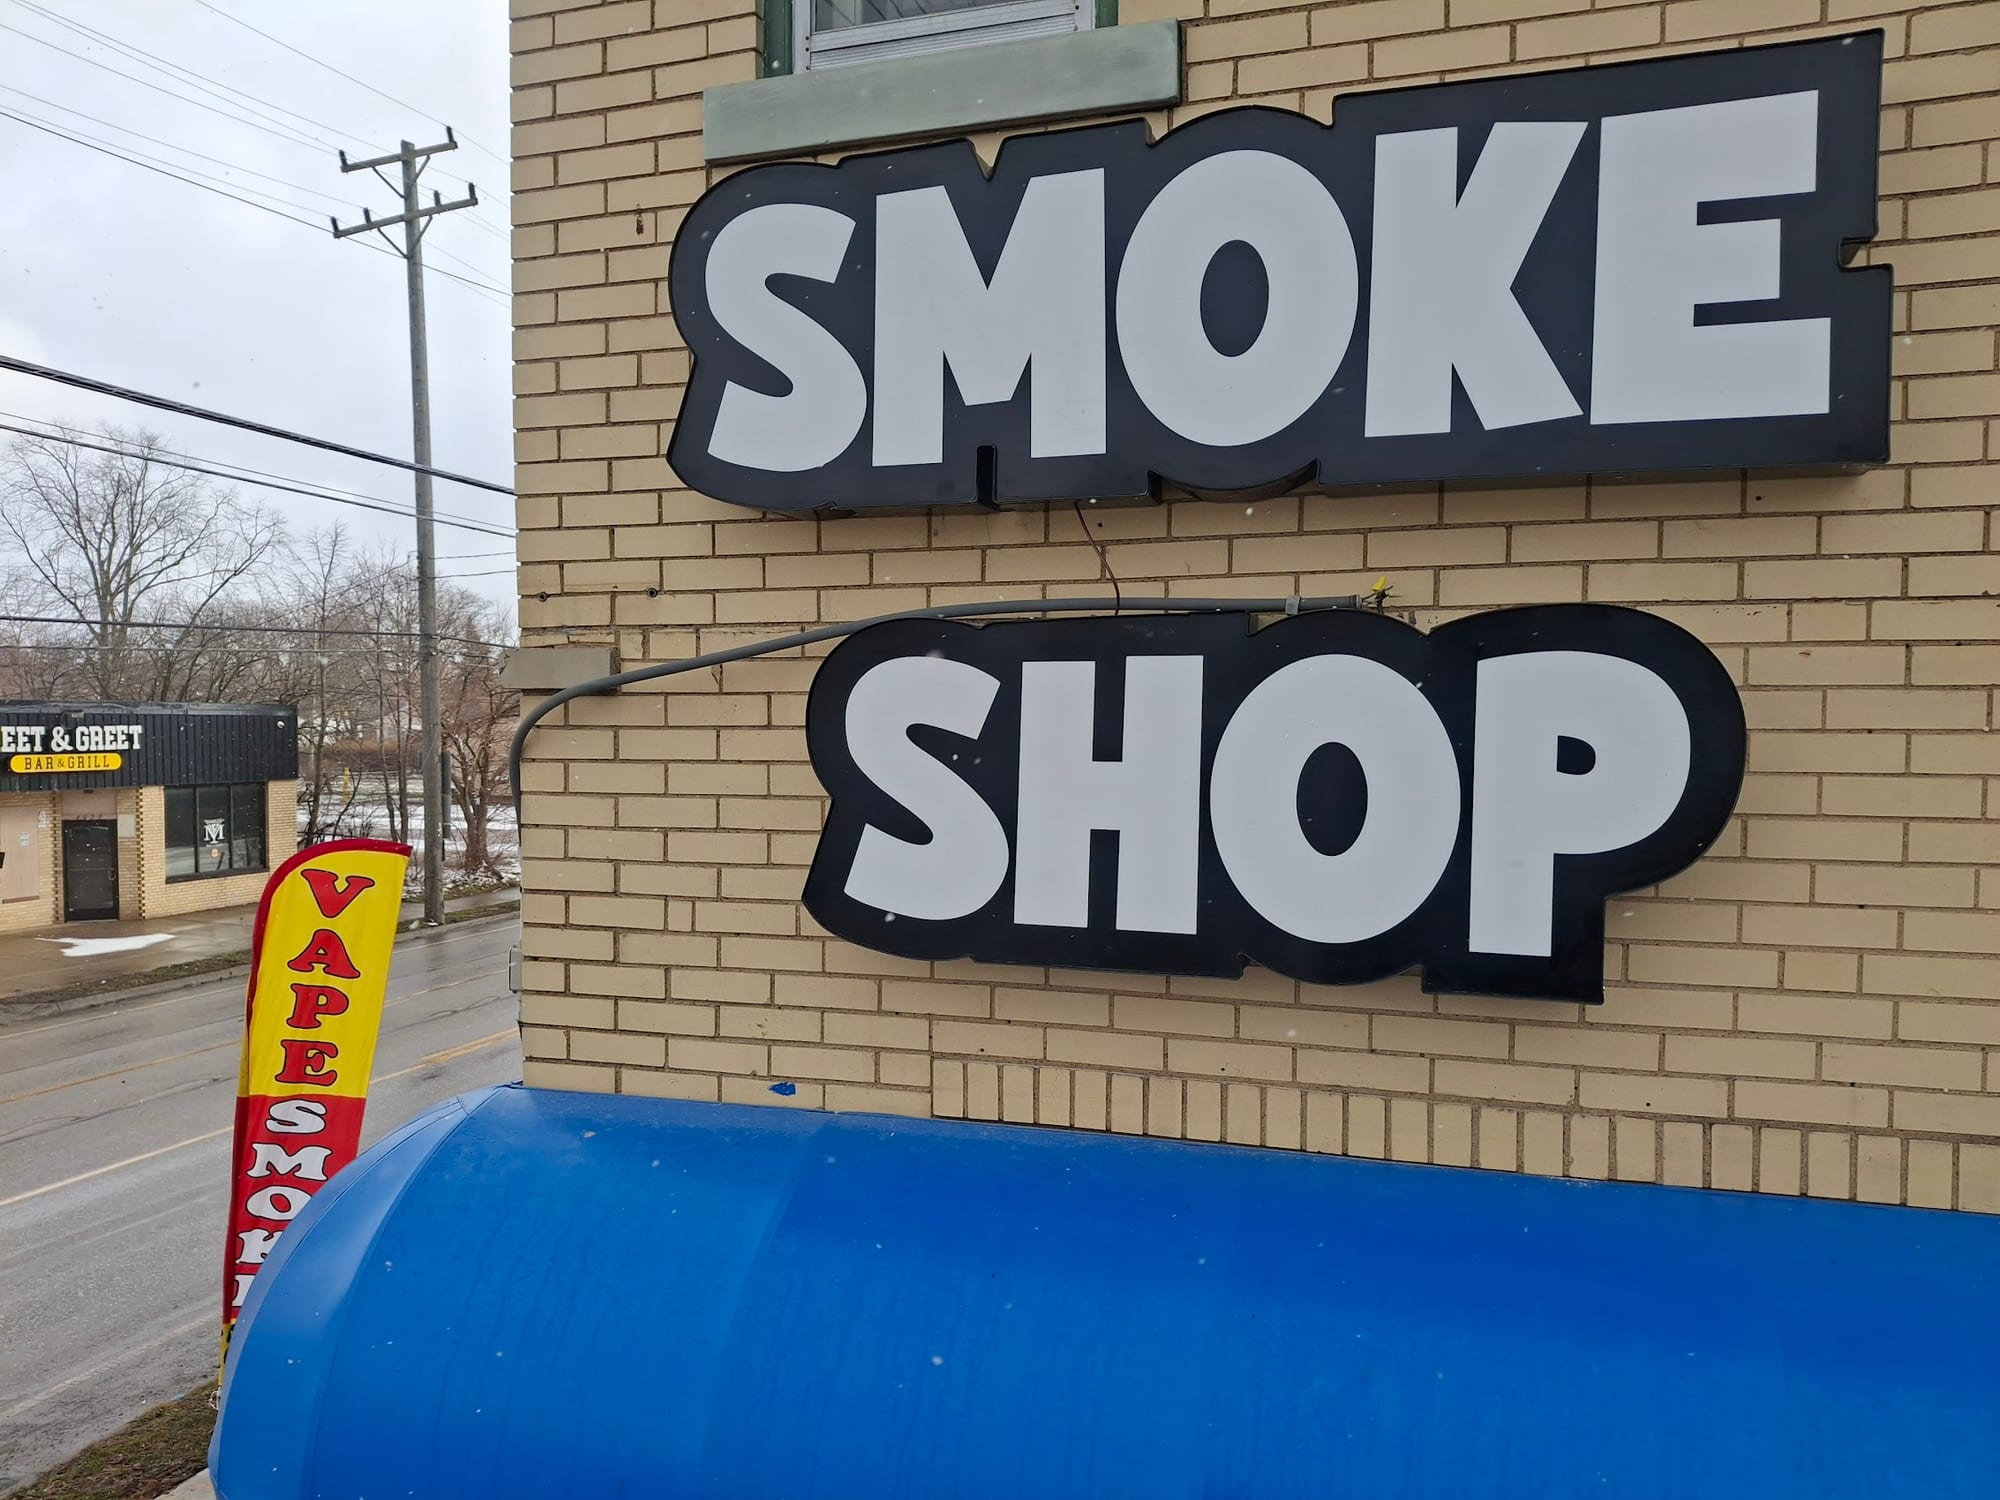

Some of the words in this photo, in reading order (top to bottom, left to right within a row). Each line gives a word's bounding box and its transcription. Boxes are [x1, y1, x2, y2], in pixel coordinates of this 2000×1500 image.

[705, 90, 1830, 472] SMOKE
[24, 757, 54, 770] BAR
[57, 758, 65, 767] &
[68, 755, 110, 768] GRILL
[51, 726, 73, 752] &
[75, 725, 142, 751] GREET
[844, 651, 1691, 957] SHOP
[275, 868, 376, 1087] VAPE
